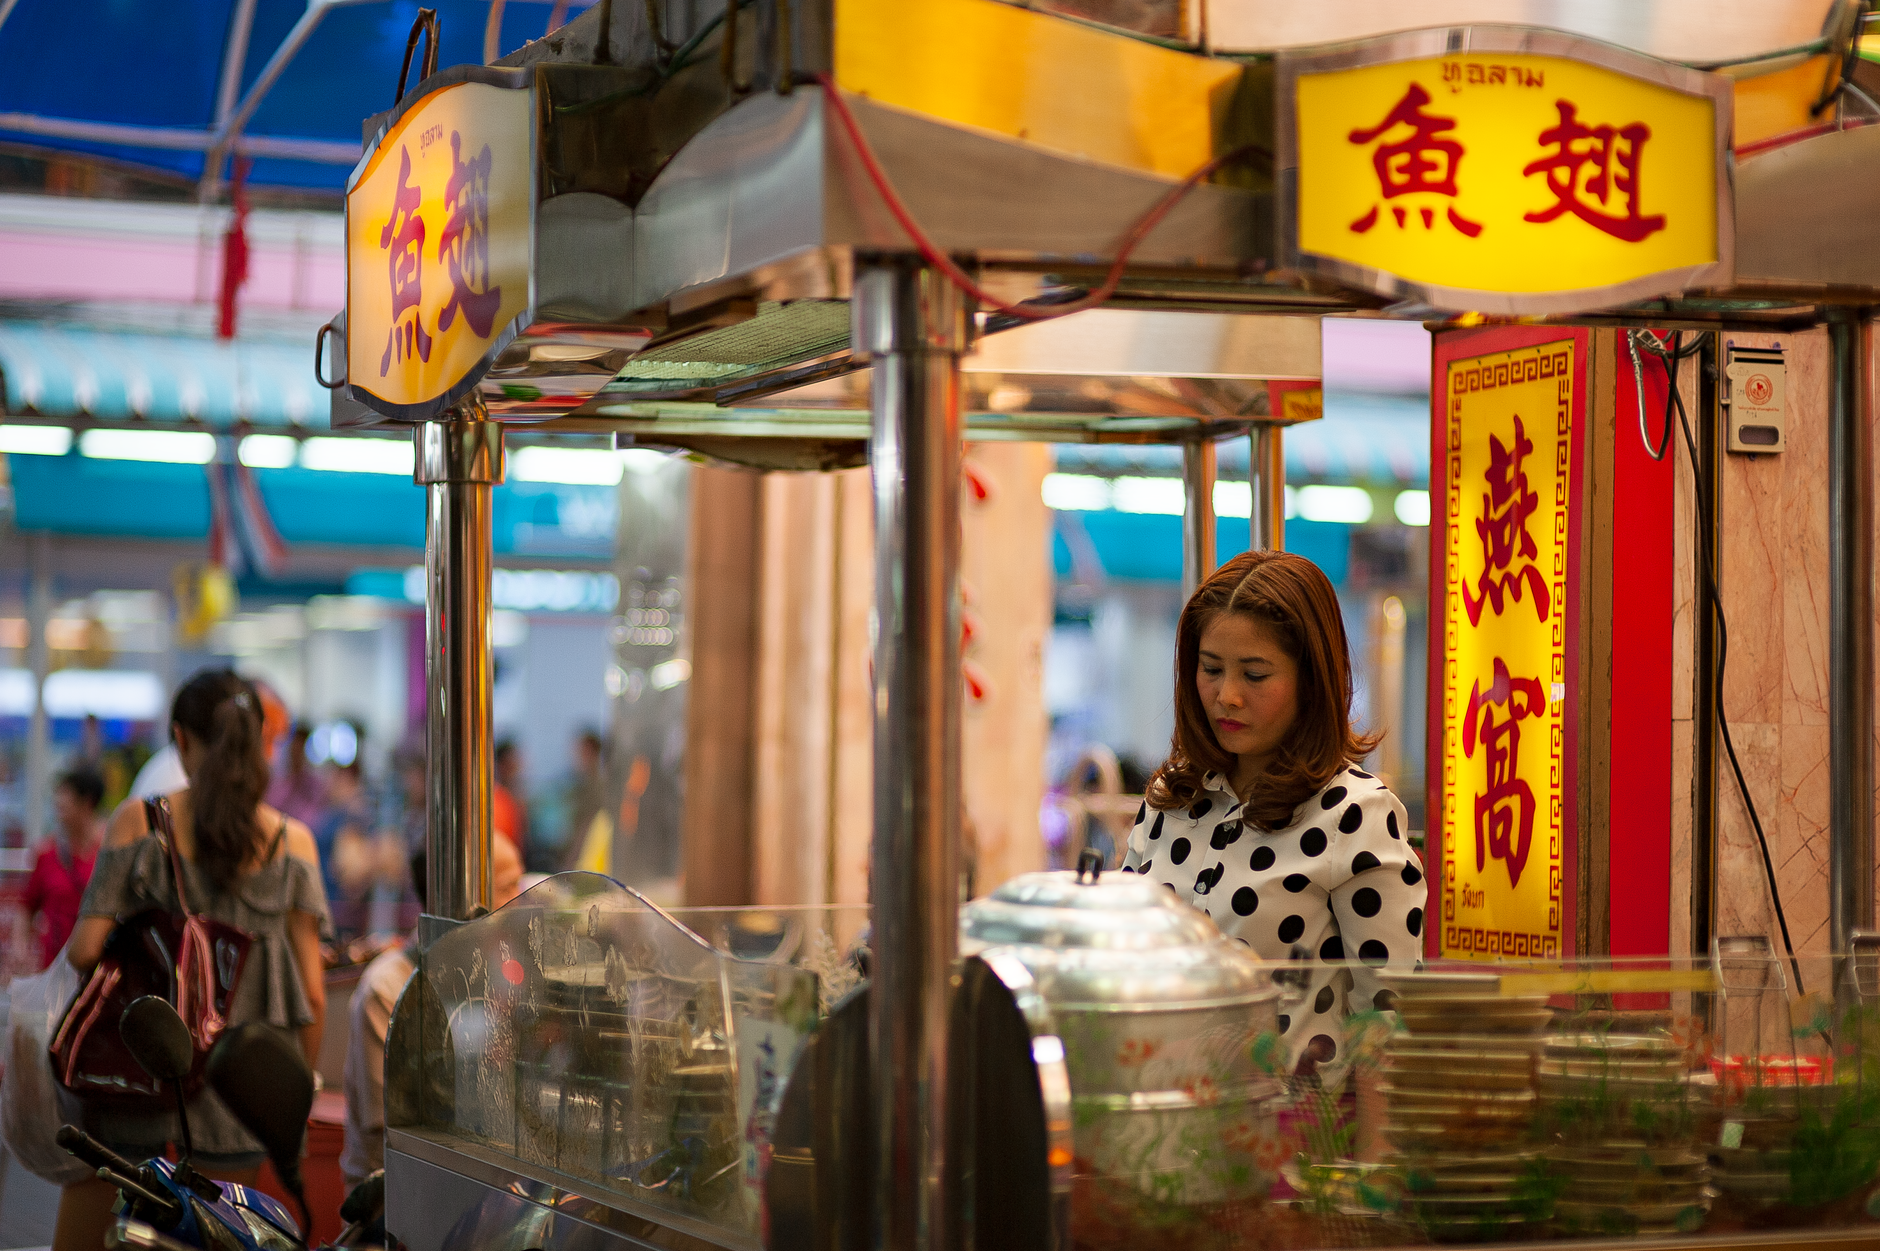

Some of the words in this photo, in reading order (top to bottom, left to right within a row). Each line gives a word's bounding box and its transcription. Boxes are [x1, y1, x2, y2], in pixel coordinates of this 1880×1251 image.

[380, 129, 500, 377] 魚翅
[1348, 82, 1668, 243] 魚翅
[1462, 413, 1550, 890] 燕窩
